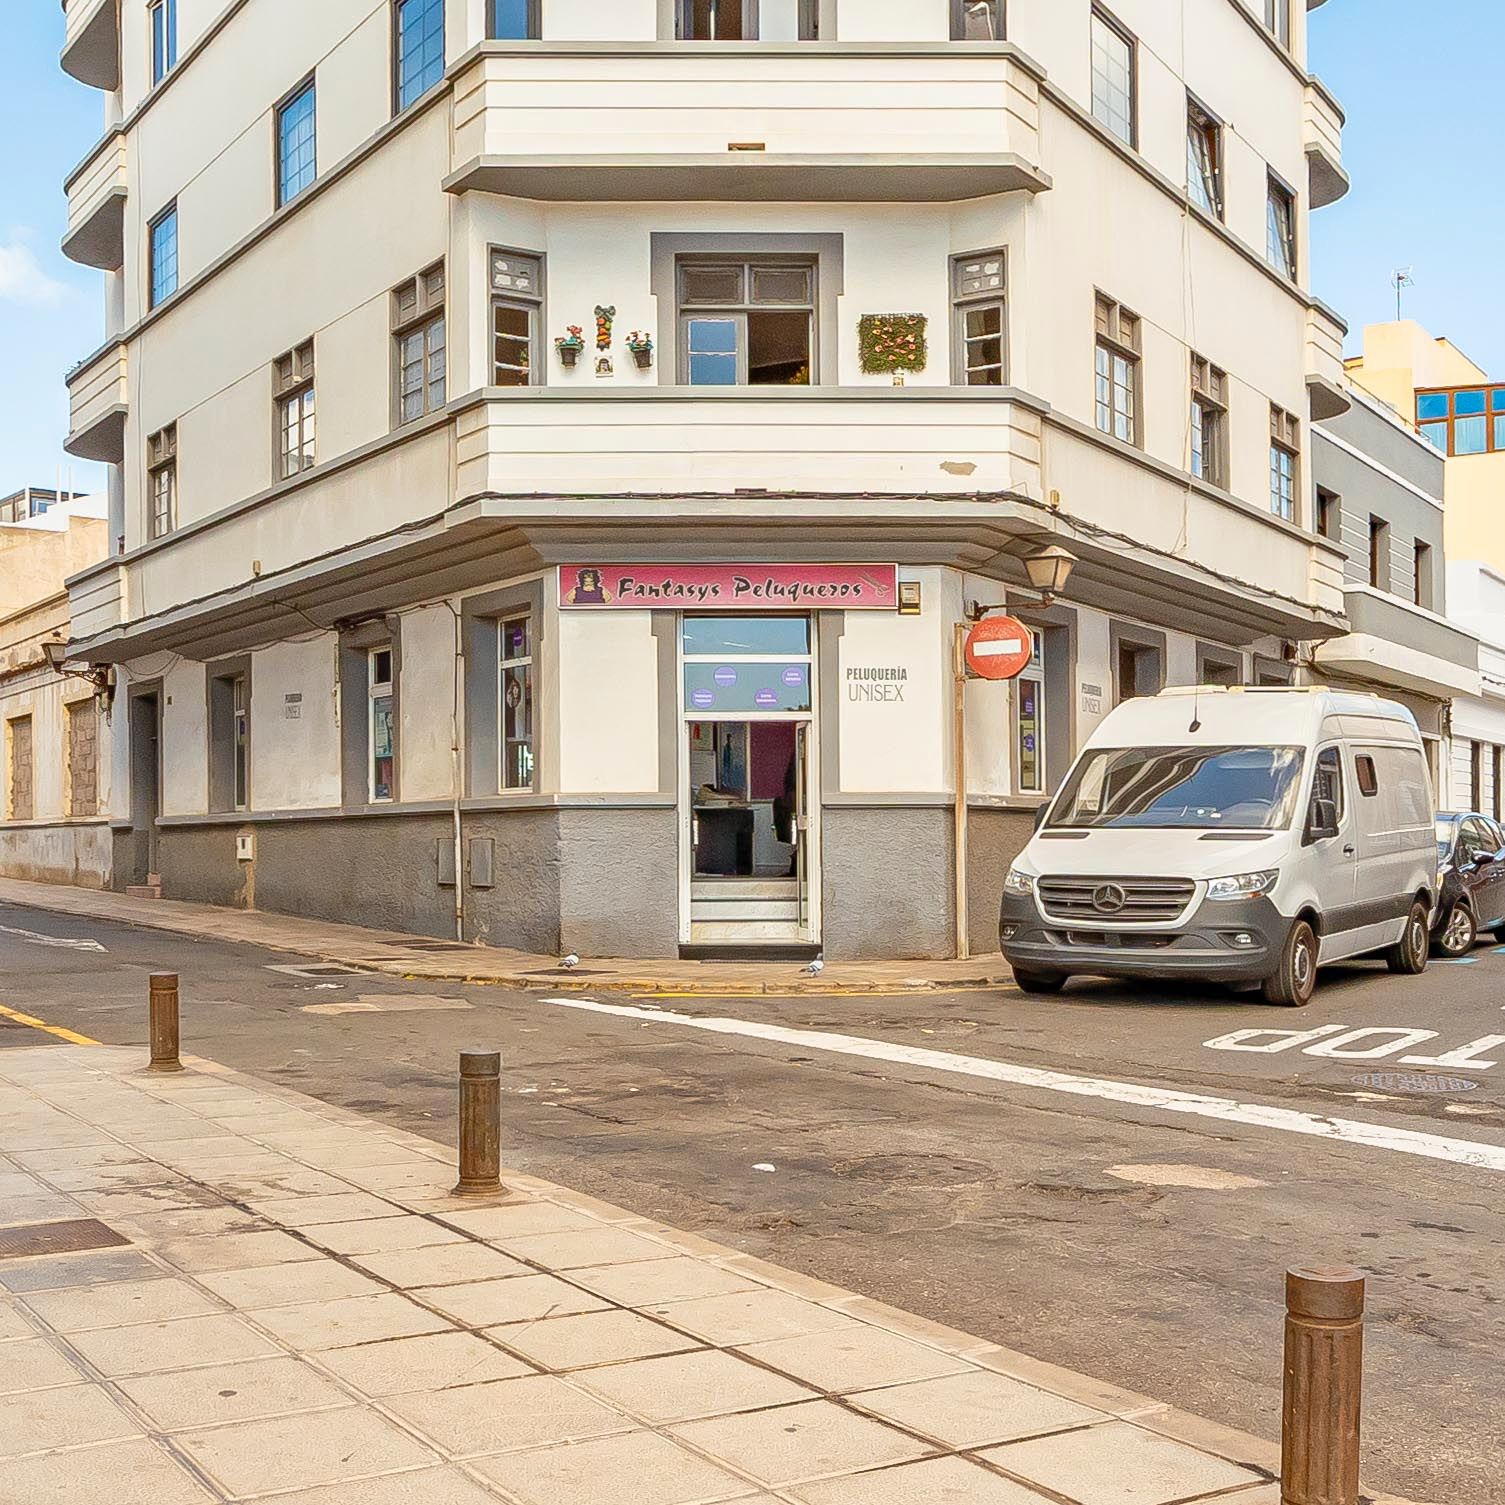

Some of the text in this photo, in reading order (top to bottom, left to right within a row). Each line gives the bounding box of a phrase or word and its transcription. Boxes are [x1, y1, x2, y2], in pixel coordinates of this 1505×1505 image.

[617, 576, 863, 603] Fantasys Peluqueros
[846, 665, 908, 682] PELUQUERÍA
[848, 683, 904, 702] UNISEX
